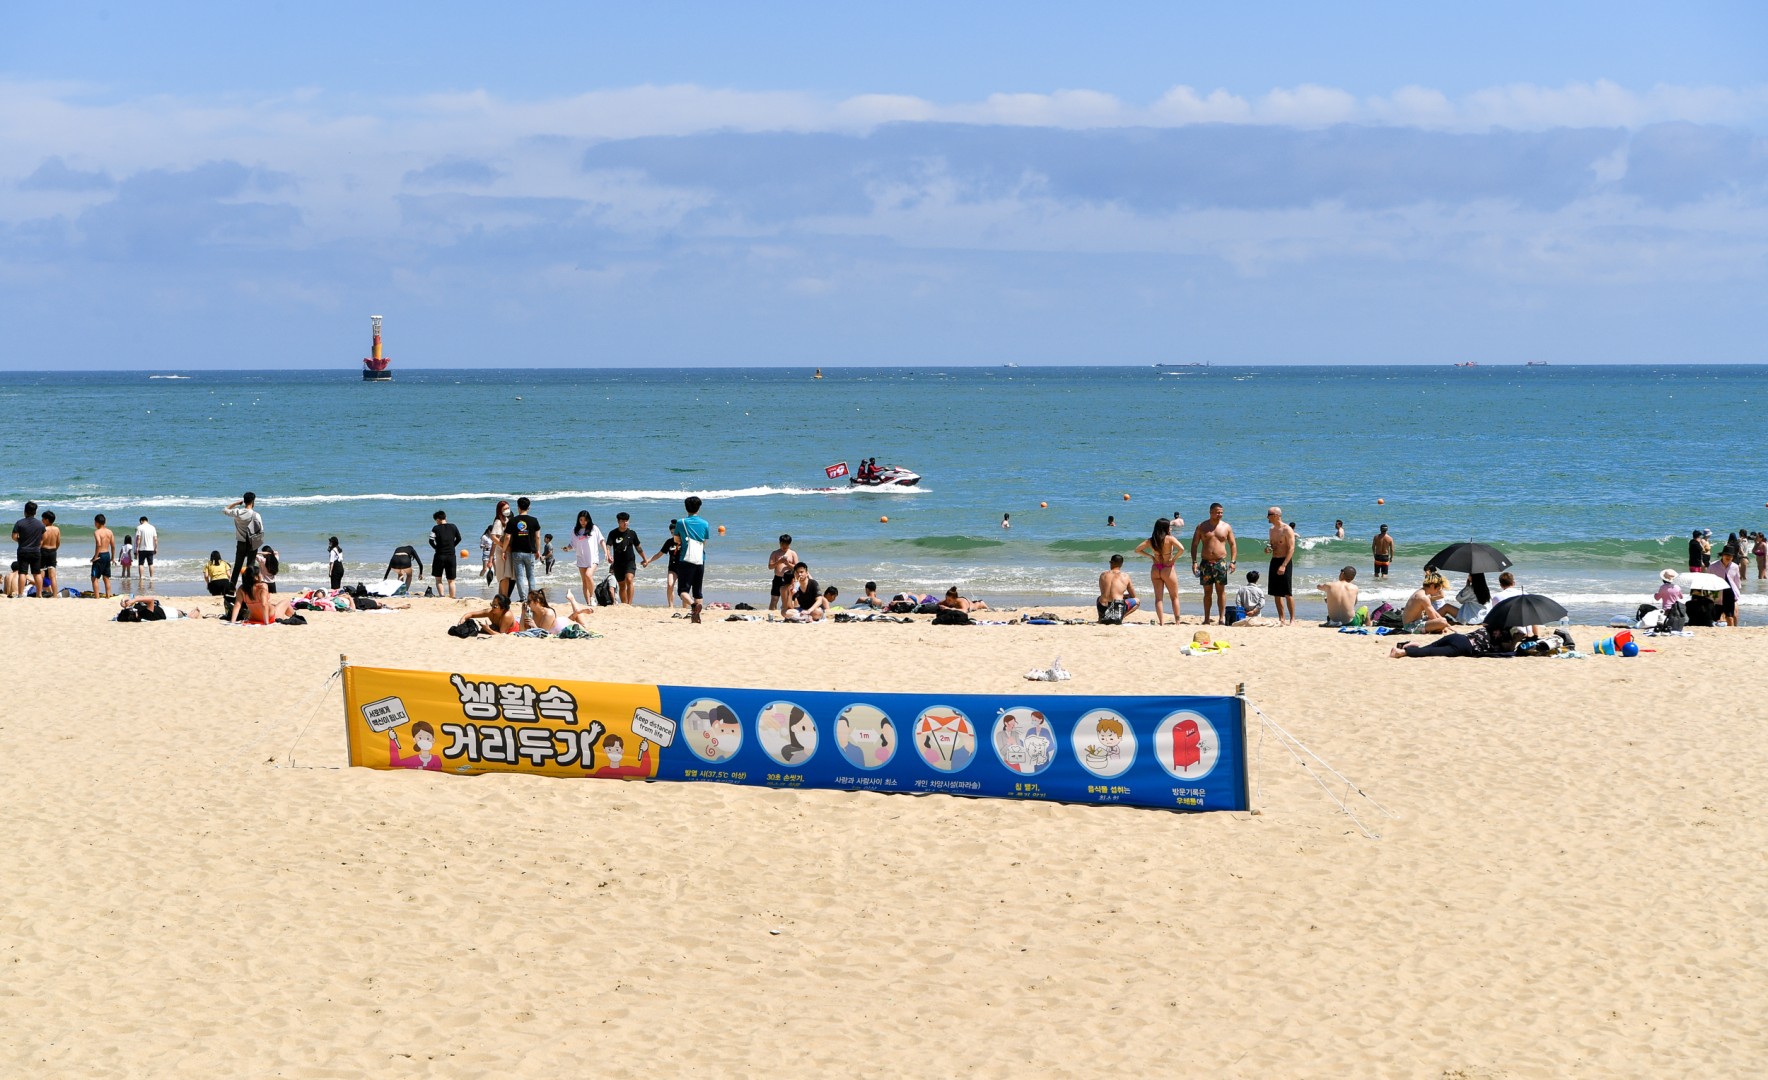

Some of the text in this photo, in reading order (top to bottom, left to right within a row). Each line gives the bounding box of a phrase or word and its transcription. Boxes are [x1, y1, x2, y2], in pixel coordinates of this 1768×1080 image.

[368, 705, 391, 718] 서로에게
[371, 710, 407, 726] 백신이 됩니다
[635, 713, 672, 735] Keep distance
[639, 723, 664, 739] from life
[940, 734, 951, 742] 2m
[441, 720, 602, 768] 거리두기
[684, 769, 698, 778] 발열
[731, 771, 747, 780] 이상)
[766, 773, 781, 781] 30초
[834, 776, 898, 786] 사람과 사람사이 최소
[914, 779, 981, 790] 개인 차양시설(파라솔)
[1087, 785, 1131, 795] 음식물 섭취는
[1172, 787, 1206, 797] 방문기록은
[1176, 797, 1204, 806] 우체통에
